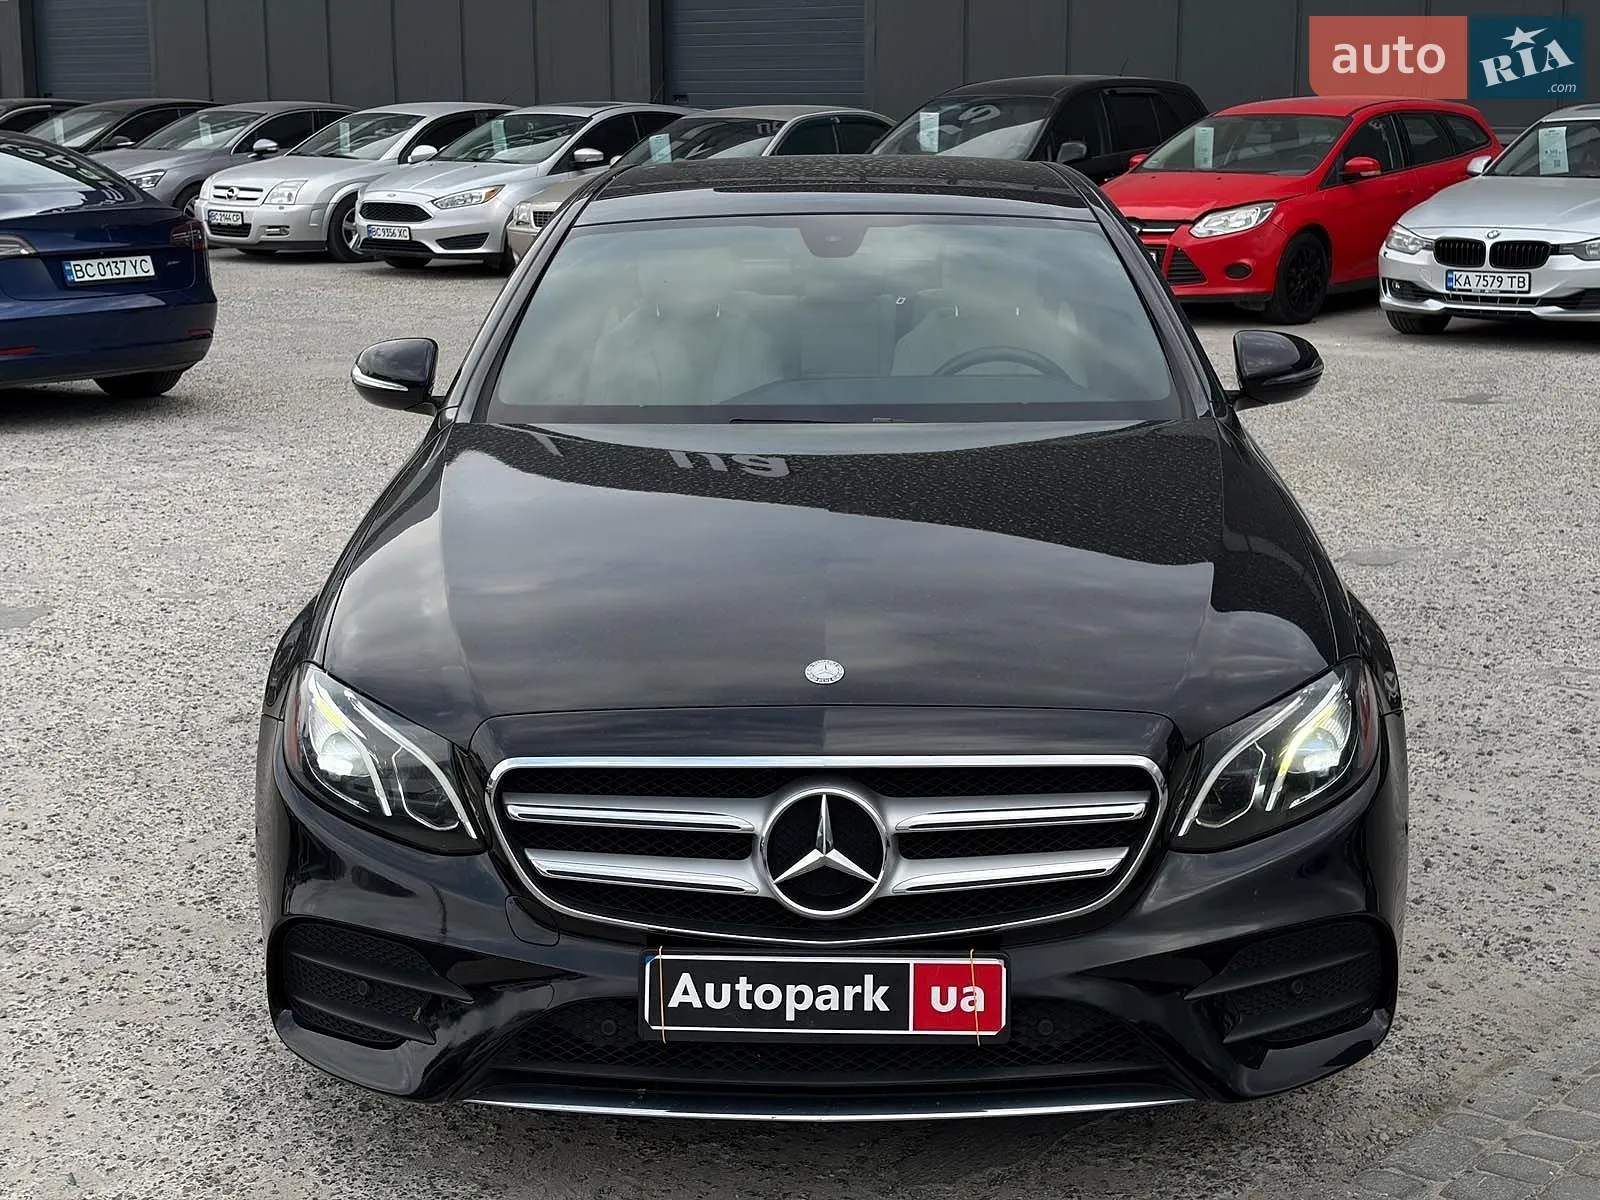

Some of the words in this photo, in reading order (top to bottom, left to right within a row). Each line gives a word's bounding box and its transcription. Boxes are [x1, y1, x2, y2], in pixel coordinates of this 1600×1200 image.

[371, 227, 381, 237] BC
[398, 229, 408, 239] XC
[72, 263, 96, 279] BC
[97, 260, 127, 277] 0137
[129, 259, 150, 275] YC
[1454, 273, 1472, 287] KA
[1475, 274, 1504, 289] 7579
[1507, 275, 1526, 289] TB
[667, 972, 890, 1022] Autopark
[930, 985, 985, 1013] ua
